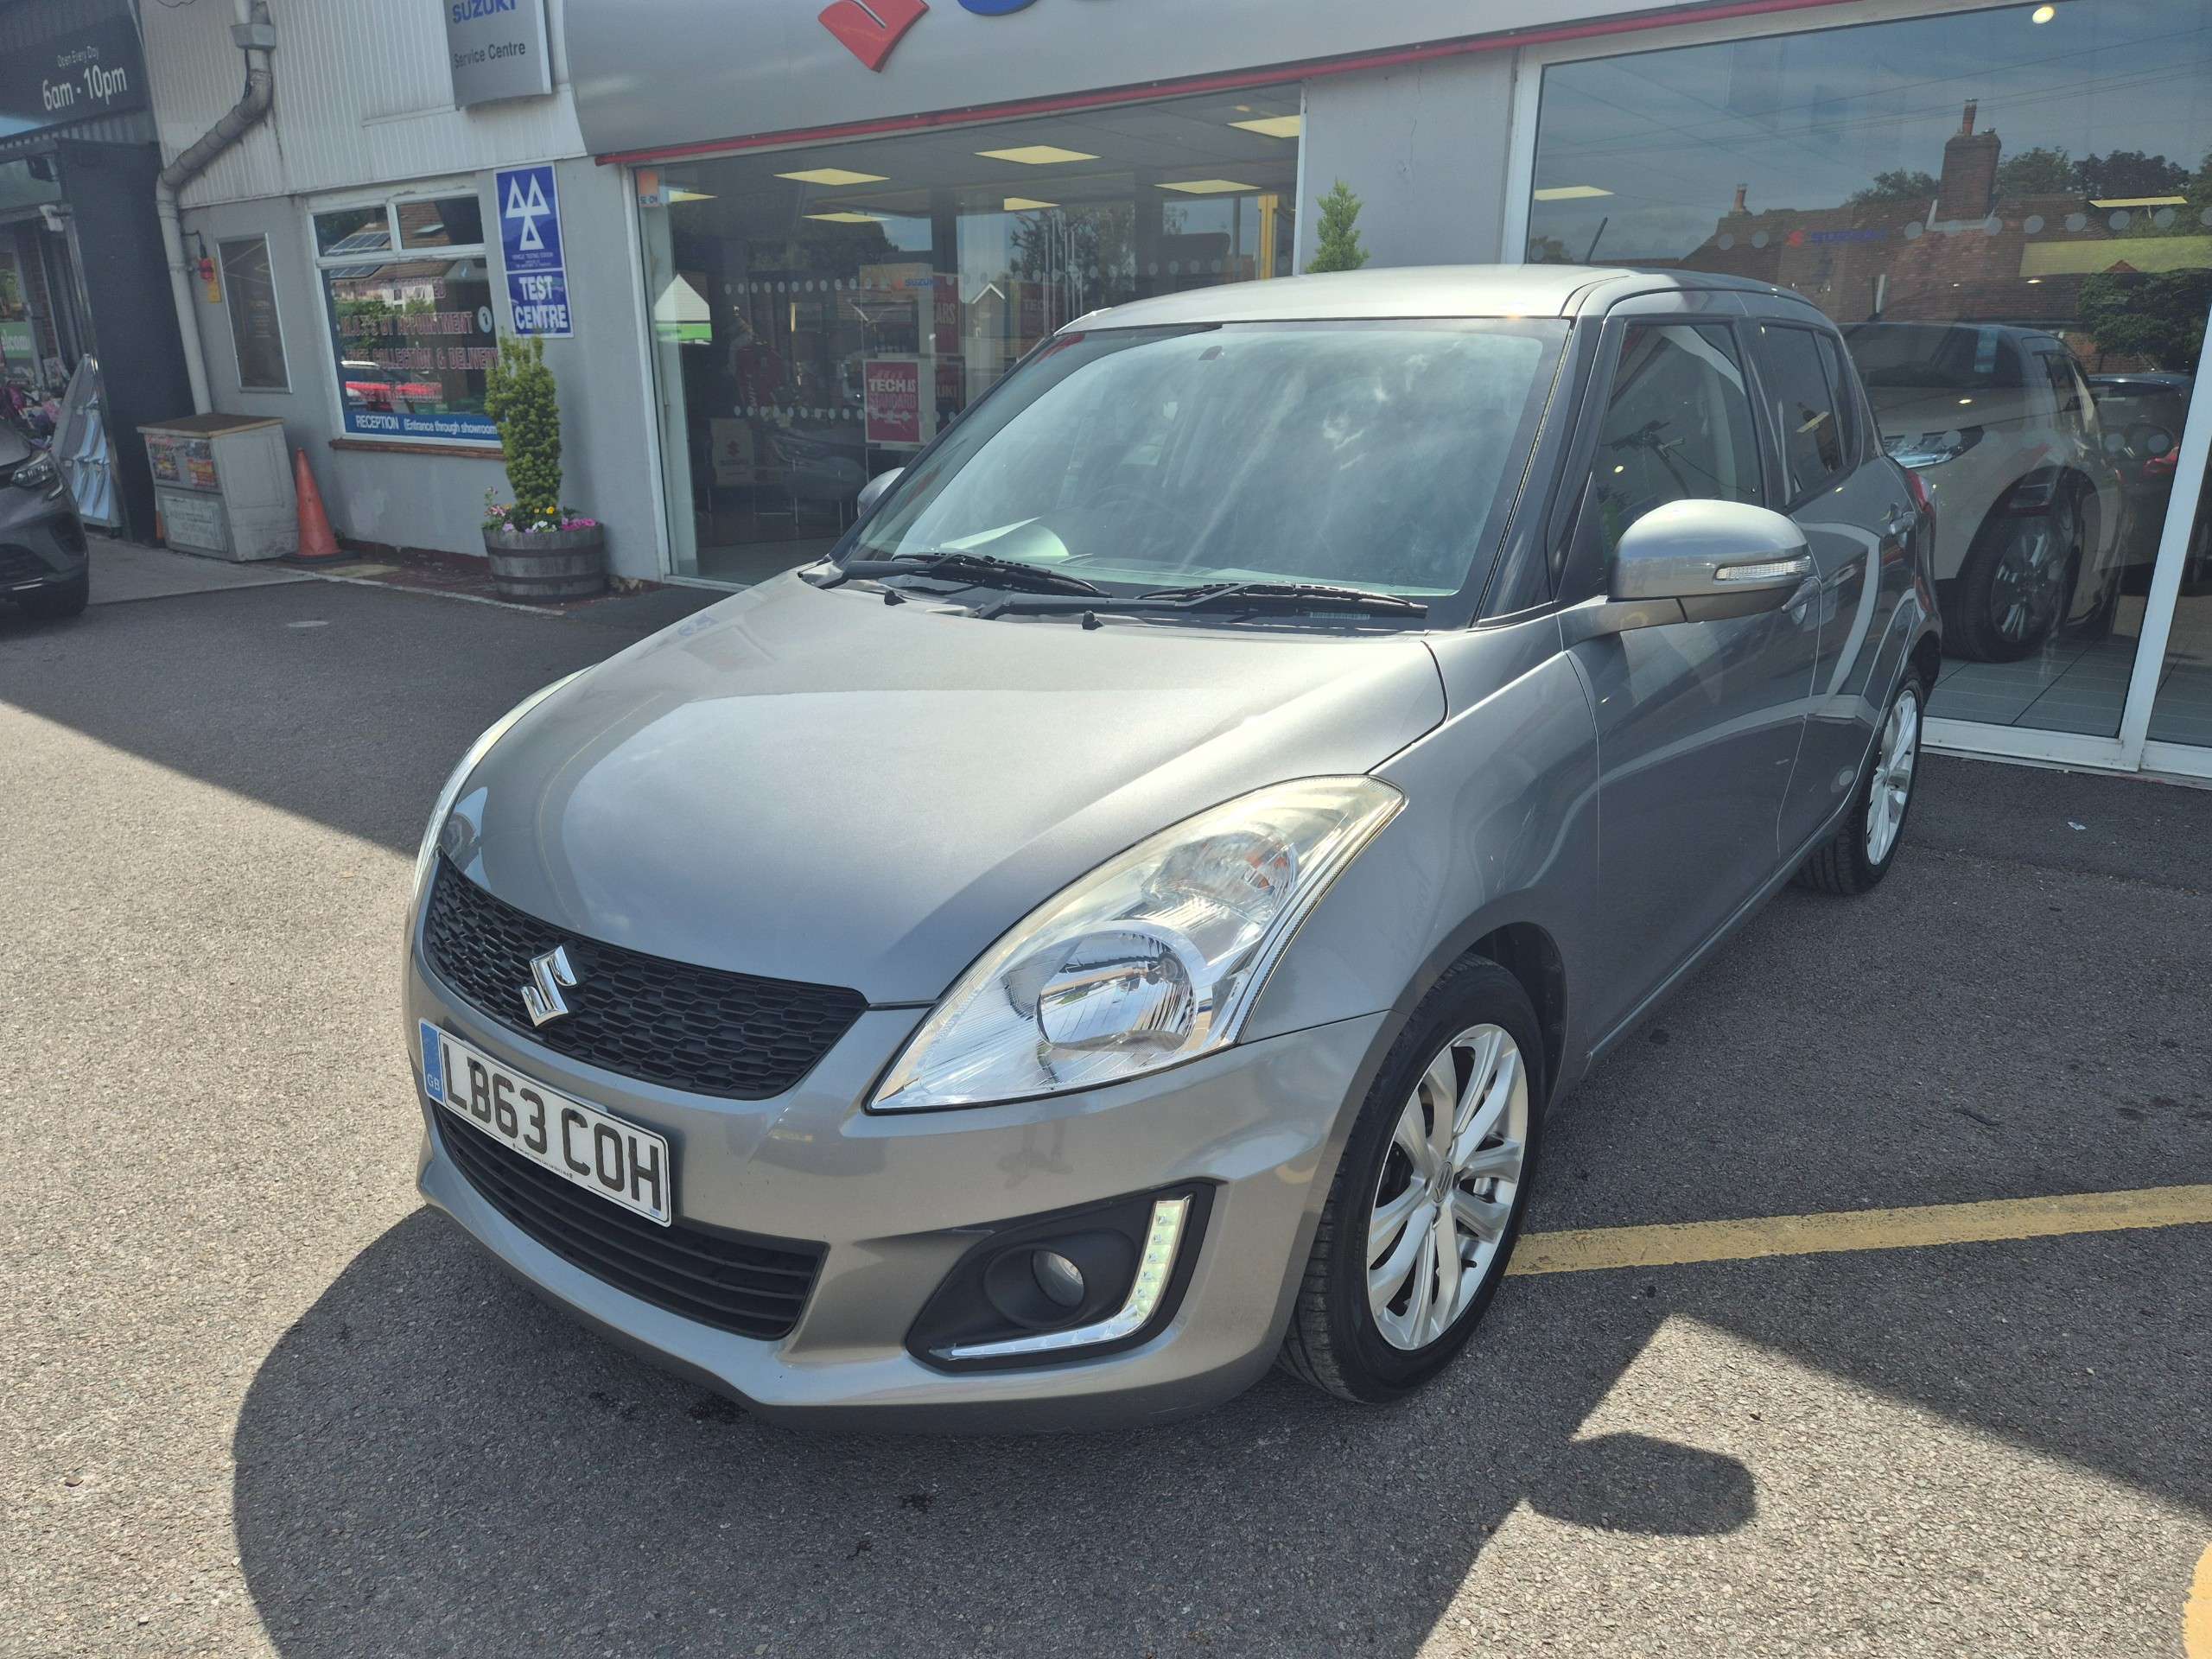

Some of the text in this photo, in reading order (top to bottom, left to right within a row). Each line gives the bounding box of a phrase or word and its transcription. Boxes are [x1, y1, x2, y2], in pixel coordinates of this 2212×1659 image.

[57, 46, 99, 69] Open Every Day
[454, 41, 526, 69] Service Centre
[42, 79, 74, 111] 6am
[83, 64, 127, 105] 10pm
[518, 276, 553, 301] TEST
[397, 311, 474, 335] APPOINTMENT
[515, 304, 568, 329] CENTRE
[372, 347, 431, 370] COLLECTION
[436, 347, 447, 370] &
[448, 346, 499, 370] DELIVERY
[868, 378, 906, 392] TECH
[868, 393, 917, 410] STANDARD
[355, 415, 399, 429] RECEPTION
[435, 421, 460, 435] through
[427, 1073, 441, 1092] GB
[442, 1042, 662, 1211] LB63 COH
